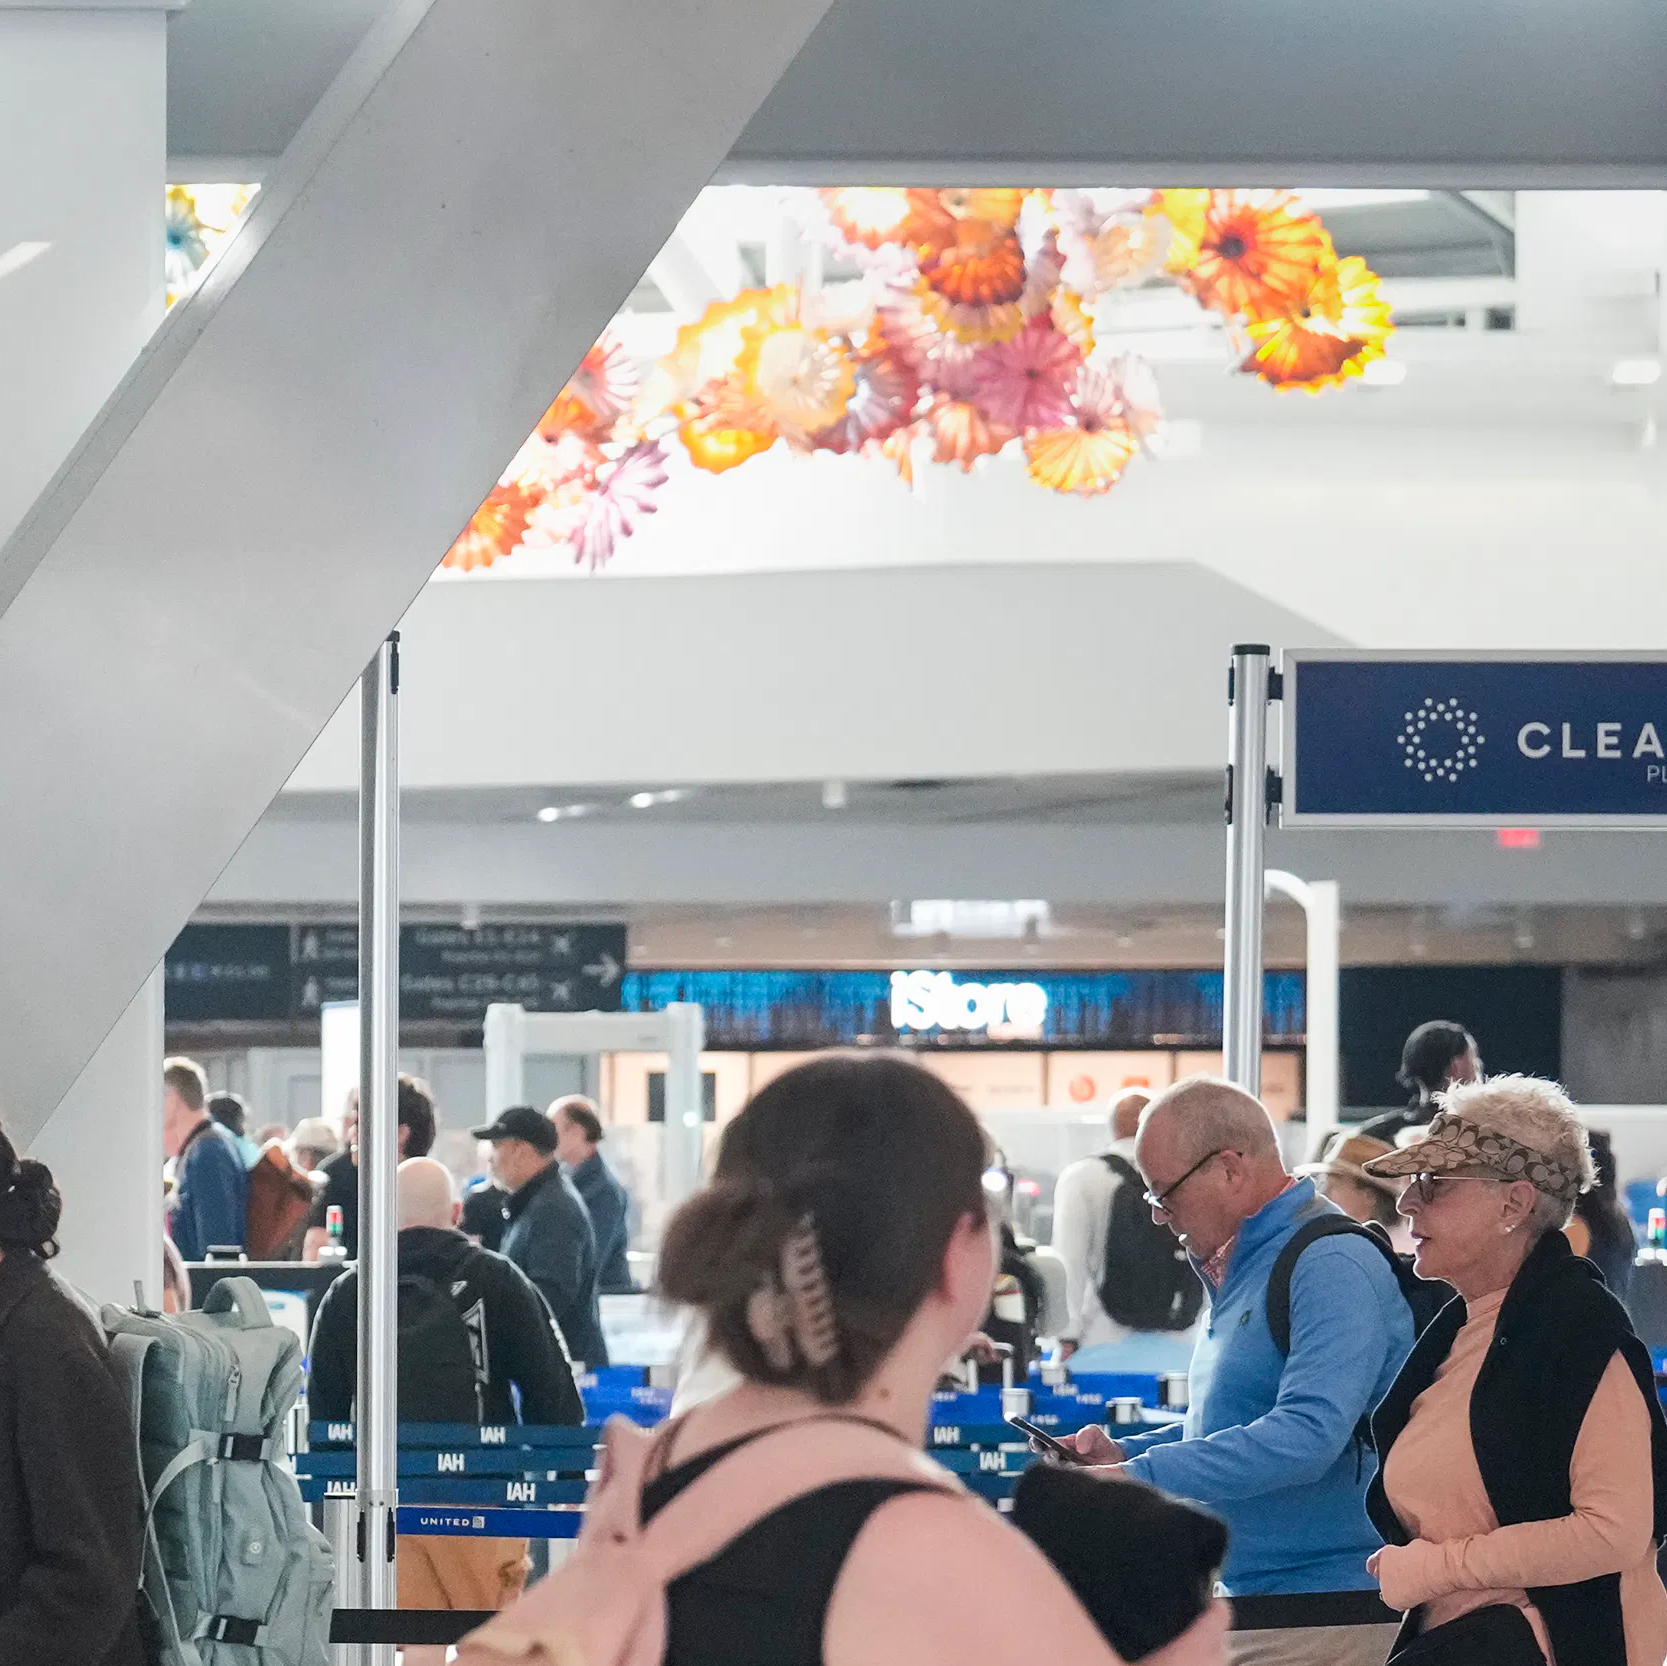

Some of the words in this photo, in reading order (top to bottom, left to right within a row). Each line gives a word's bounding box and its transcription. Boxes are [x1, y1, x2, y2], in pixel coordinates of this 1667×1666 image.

[890, 970, 1048, 1030] iStore
[328, 1423, 353, 1441] IAH
[480, 1426, 506, 1444] IAH
[933, 1426, 960, 1445] IAH
[437, 1453, 465, 1472] IAH
[979, 1451, 1007, 1471] IAH
[506, 1482, 536, 1502] IAH
[420, 1517, 470, 1527] UNITED
